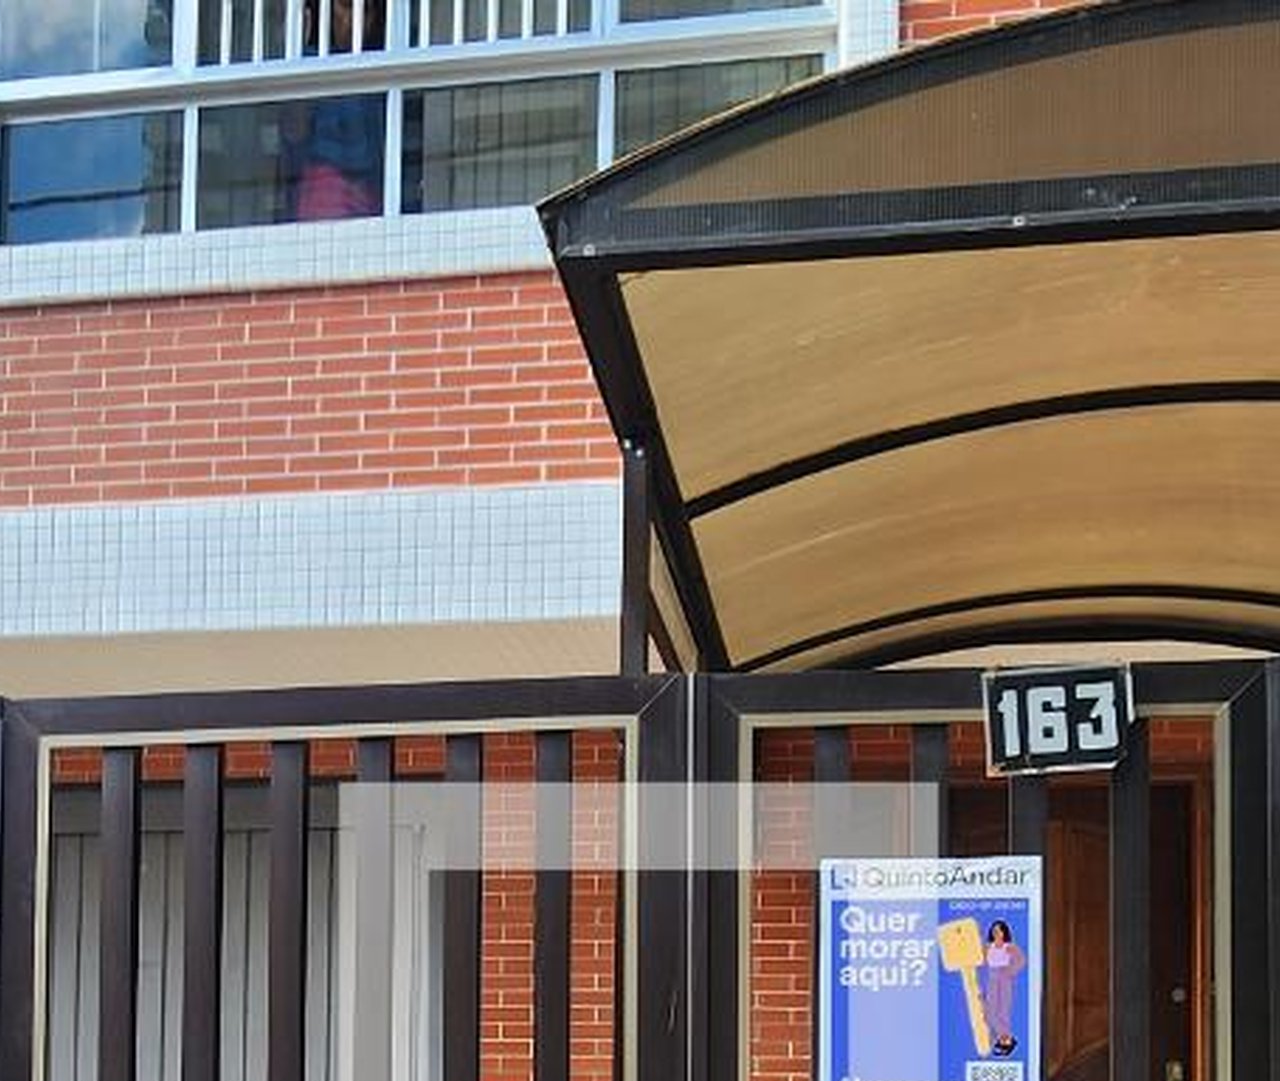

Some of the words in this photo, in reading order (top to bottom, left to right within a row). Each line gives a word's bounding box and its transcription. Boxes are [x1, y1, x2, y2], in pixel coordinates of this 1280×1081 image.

[997, 681, 1119, 757] 163
[863, 866, 1029, 888] QuintoAndar
[839, 906, 921, 934] Quer
[839, 938, 935, 959] morar
[839, 959, 927, 991] aqui?
